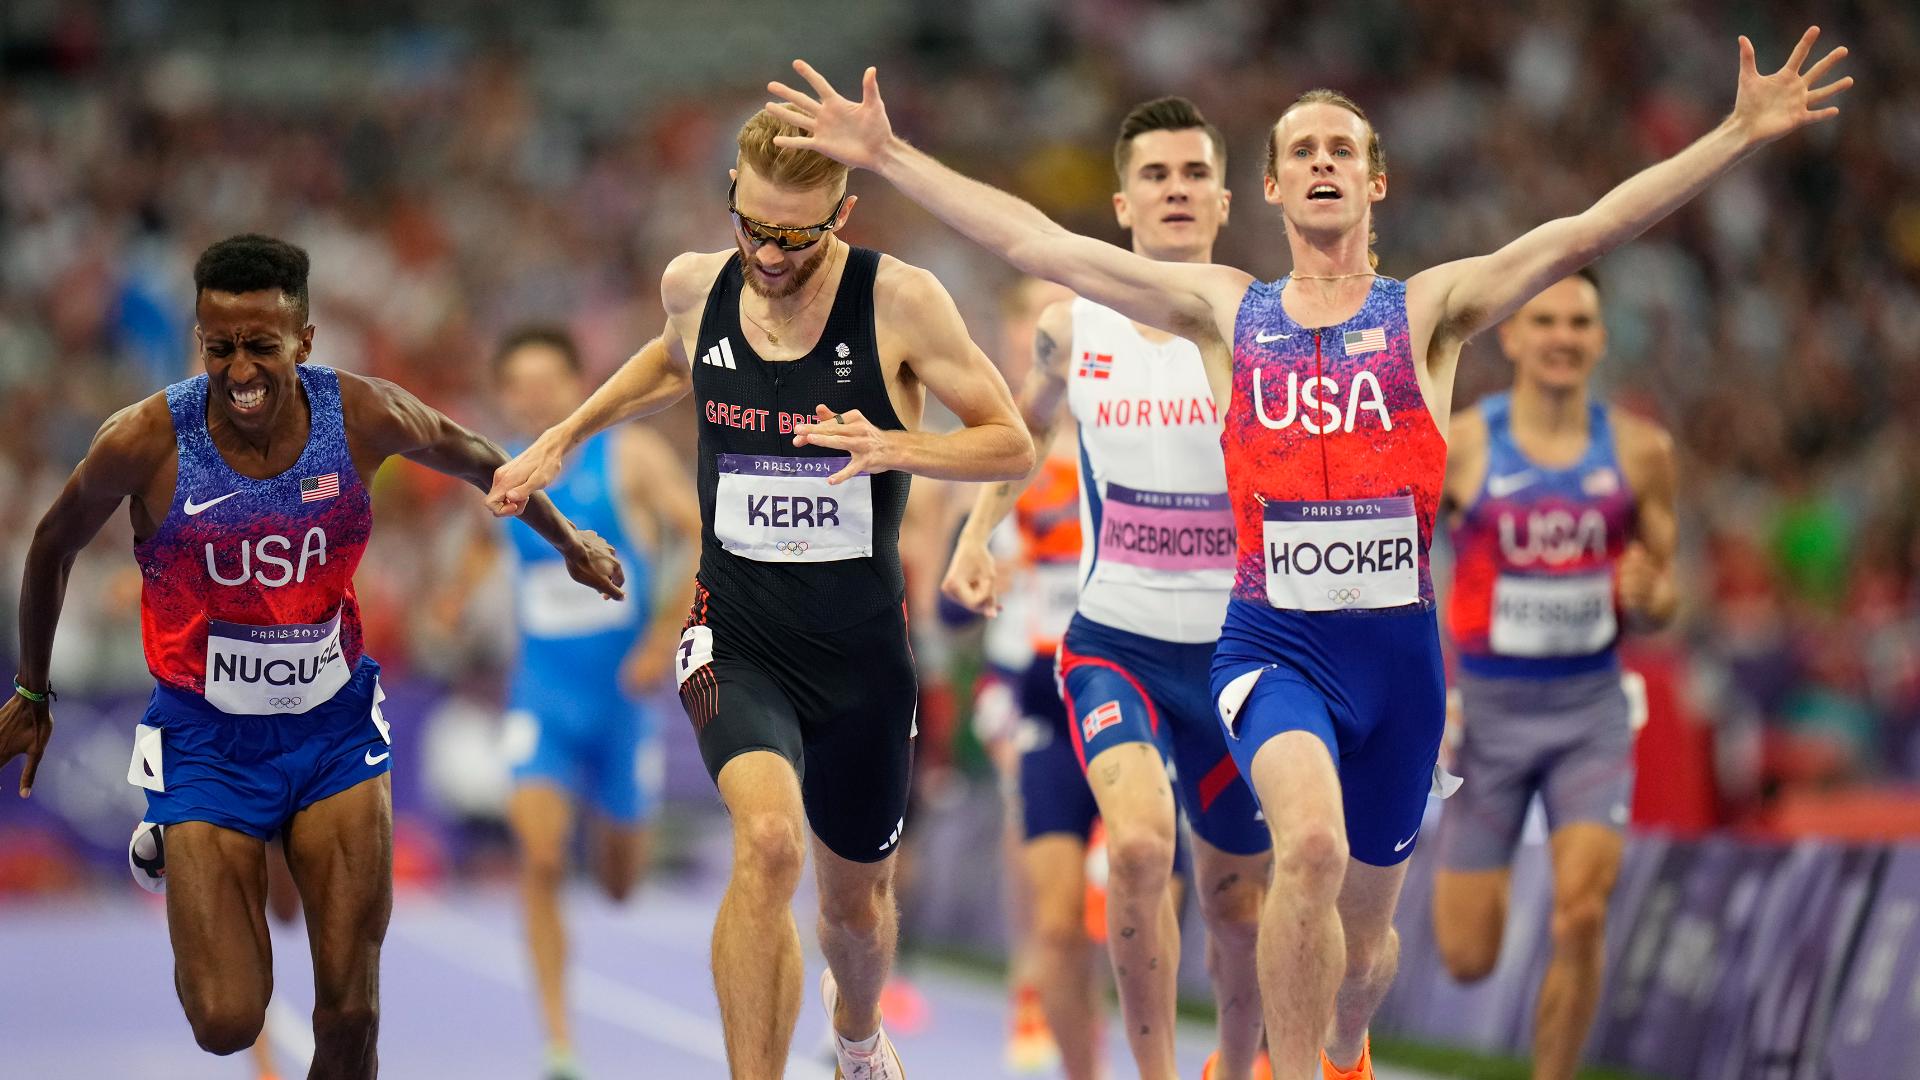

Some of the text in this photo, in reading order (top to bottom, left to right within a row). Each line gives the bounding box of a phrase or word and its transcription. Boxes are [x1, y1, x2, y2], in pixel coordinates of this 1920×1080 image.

[705, 399, 770, 432] GREAT
[1096, 397, 1219, 428] NORWAY
[1253, 367, 1393, 435] USA
[755, 461, 791, 473] PARIS
[747, 494, 840, 528] KERR
[1135, 492, 1171, 506] PARIS
[1302, 504, 1381, 517] PARIS 2024
[1104, 518, 1237, 557] INGEBRIGTSEN
[1498, 508, 1608, 567] USA
[205, 526, 327, 587] USA
[1270, 537, 1414, 575] HOCKER
[251, 629, 288, 640] PARIS
[213, 633, 340, 686] NUGUSE
